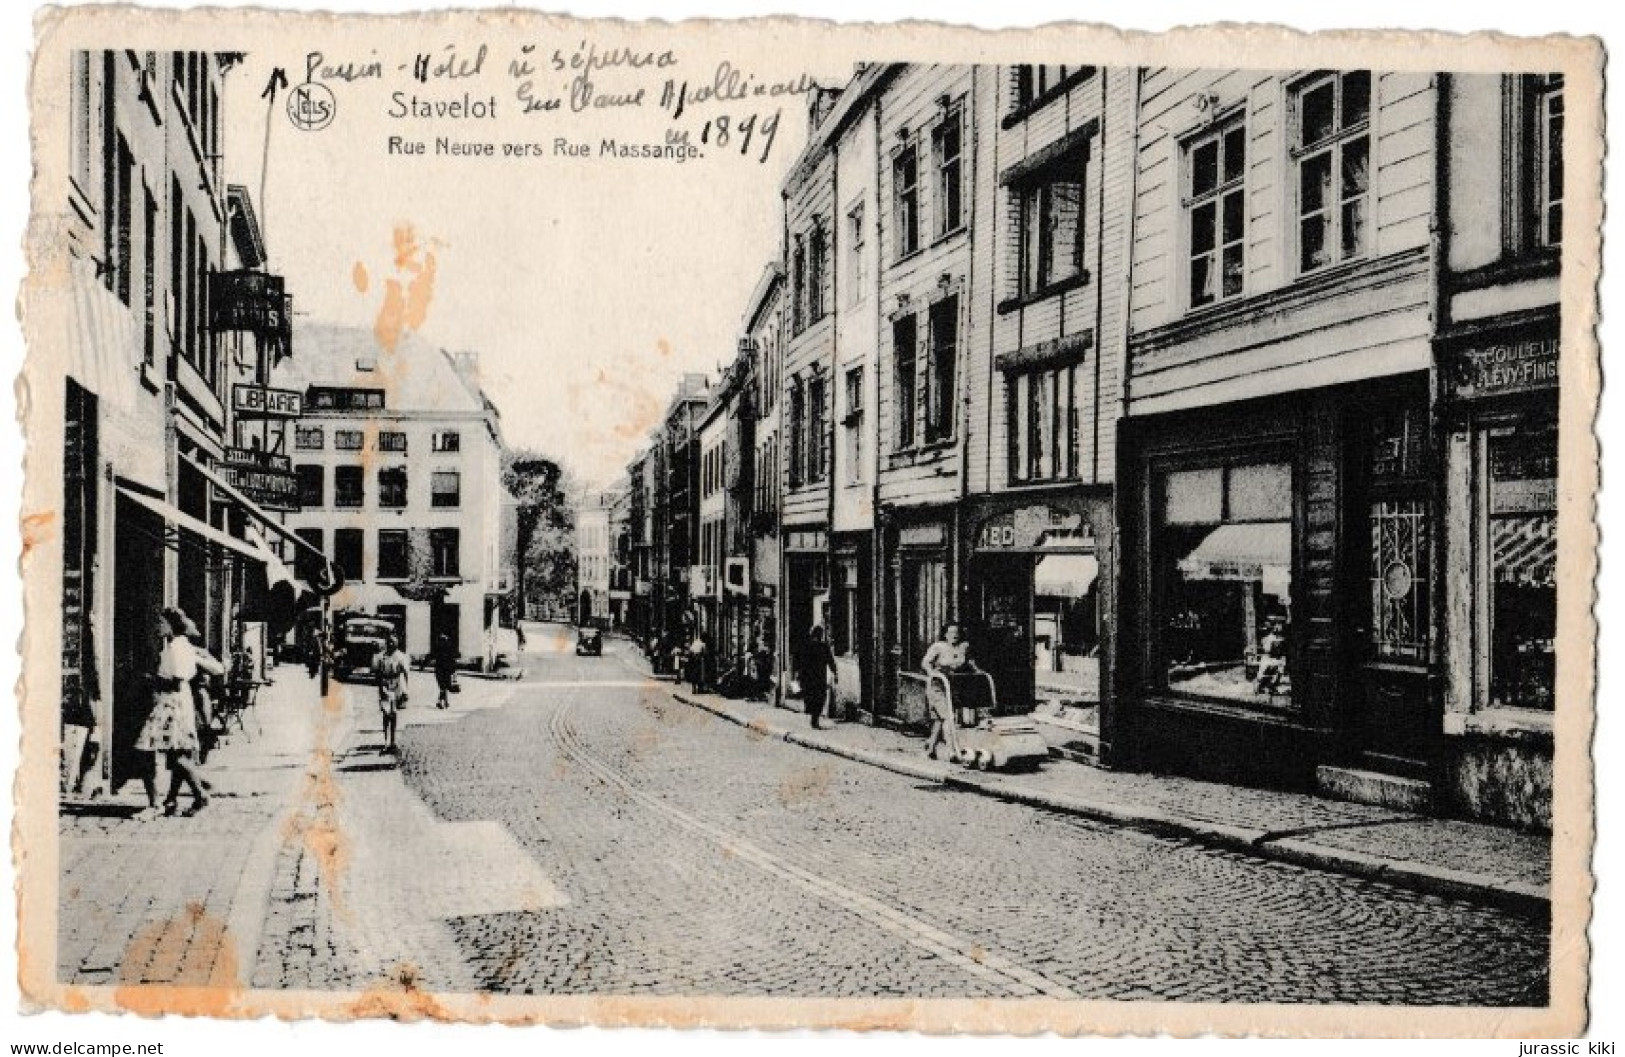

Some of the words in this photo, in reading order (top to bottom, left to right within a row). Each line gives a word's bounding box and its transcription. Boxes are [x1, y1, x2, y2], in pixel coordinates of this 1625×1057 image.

[387, 91, 497, 119] Stavelot
[388, 136, 426, 155] Rue
[435, 136, 495, 156] Neuve
[502, 141, 544, 156] vers
[553, 138, 591, 157] Rue
[598, 138, 706, 163] Massange.
[700, 107, 782, 164] 1899
